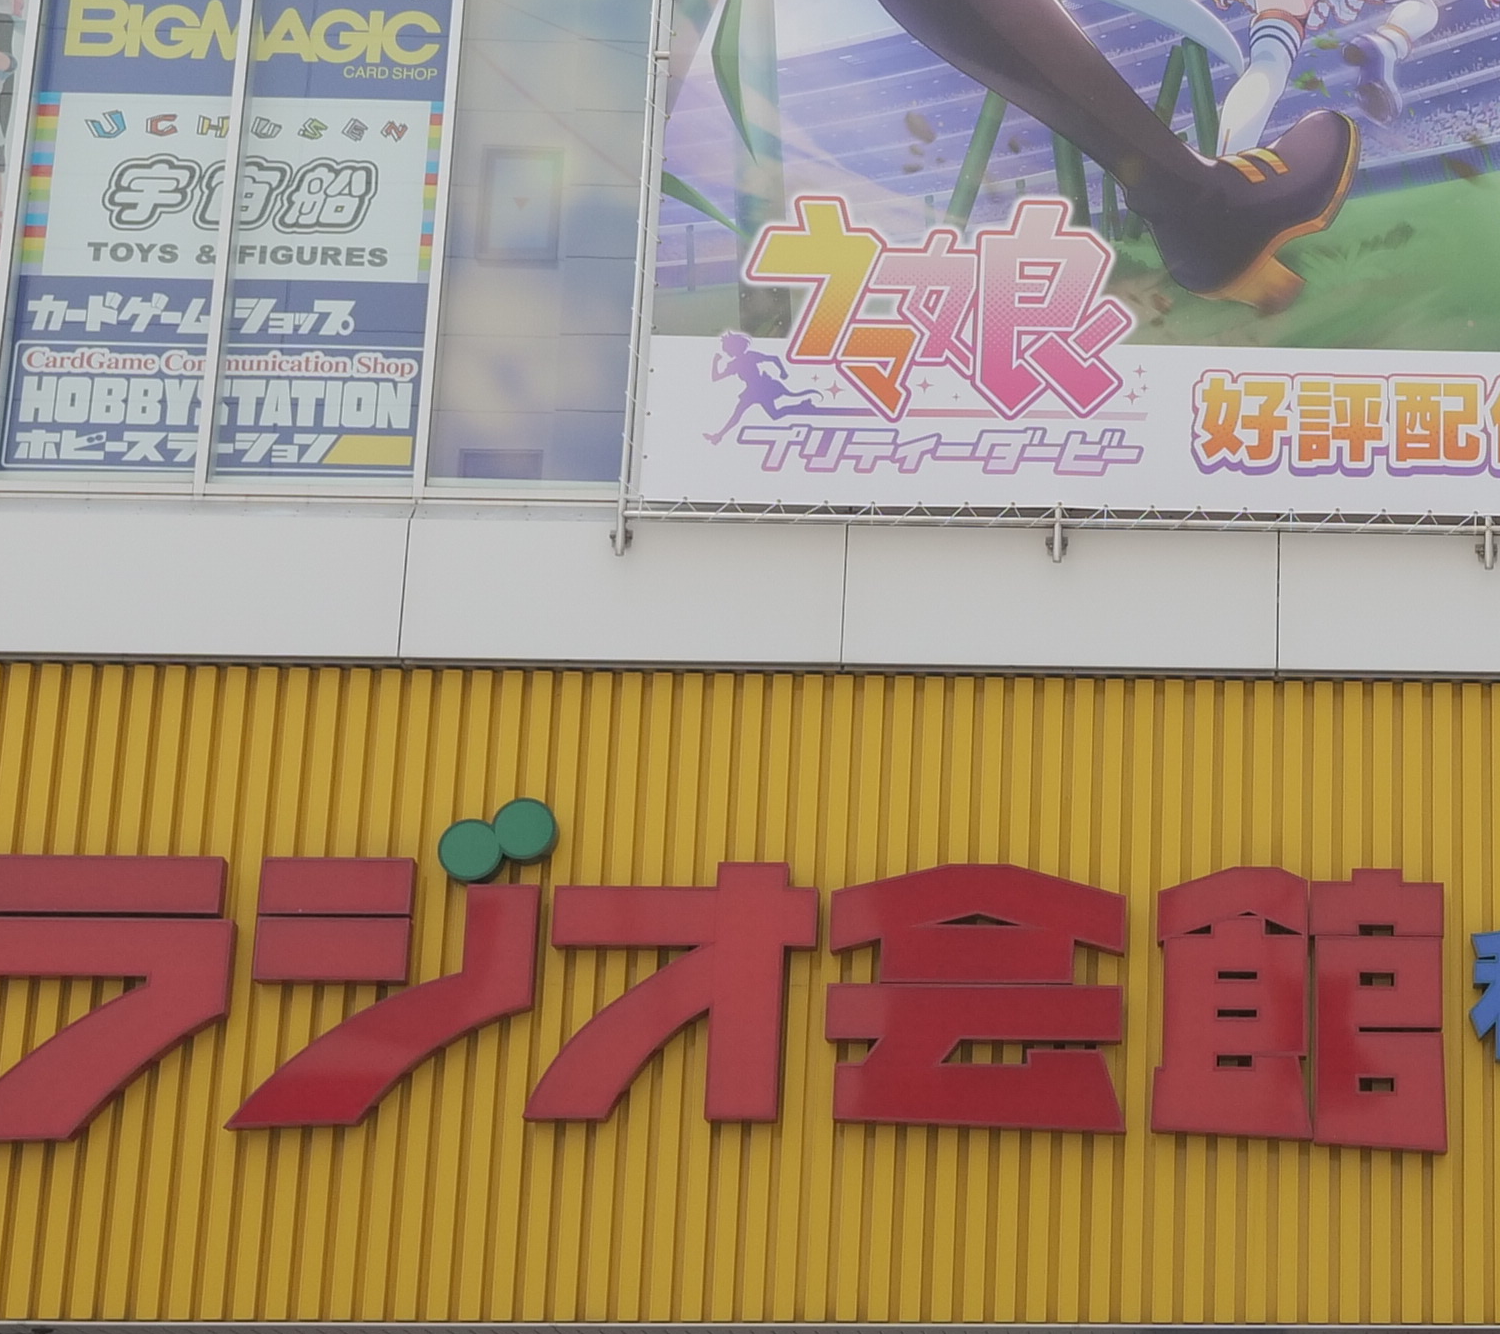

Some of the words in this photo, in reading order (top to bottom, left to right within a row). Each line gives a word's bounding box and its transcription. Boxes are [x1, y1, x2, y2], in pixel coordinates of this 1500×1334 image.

[342, 65, 390, 80] CARD
[391, 66, 438, 81] SHOP
[84, 109, 409, 143] UCHUSEN
[102, 152, 380, 236] 宇宙船
[87, 240, 179, 265] TOYS
[238, 243, 389, 269] FIGURES
[25, 349, 157, 373] CardGame
[354, 357, 416, 379] Shop
[737, 424, 1146, 476] プリティーダービー
